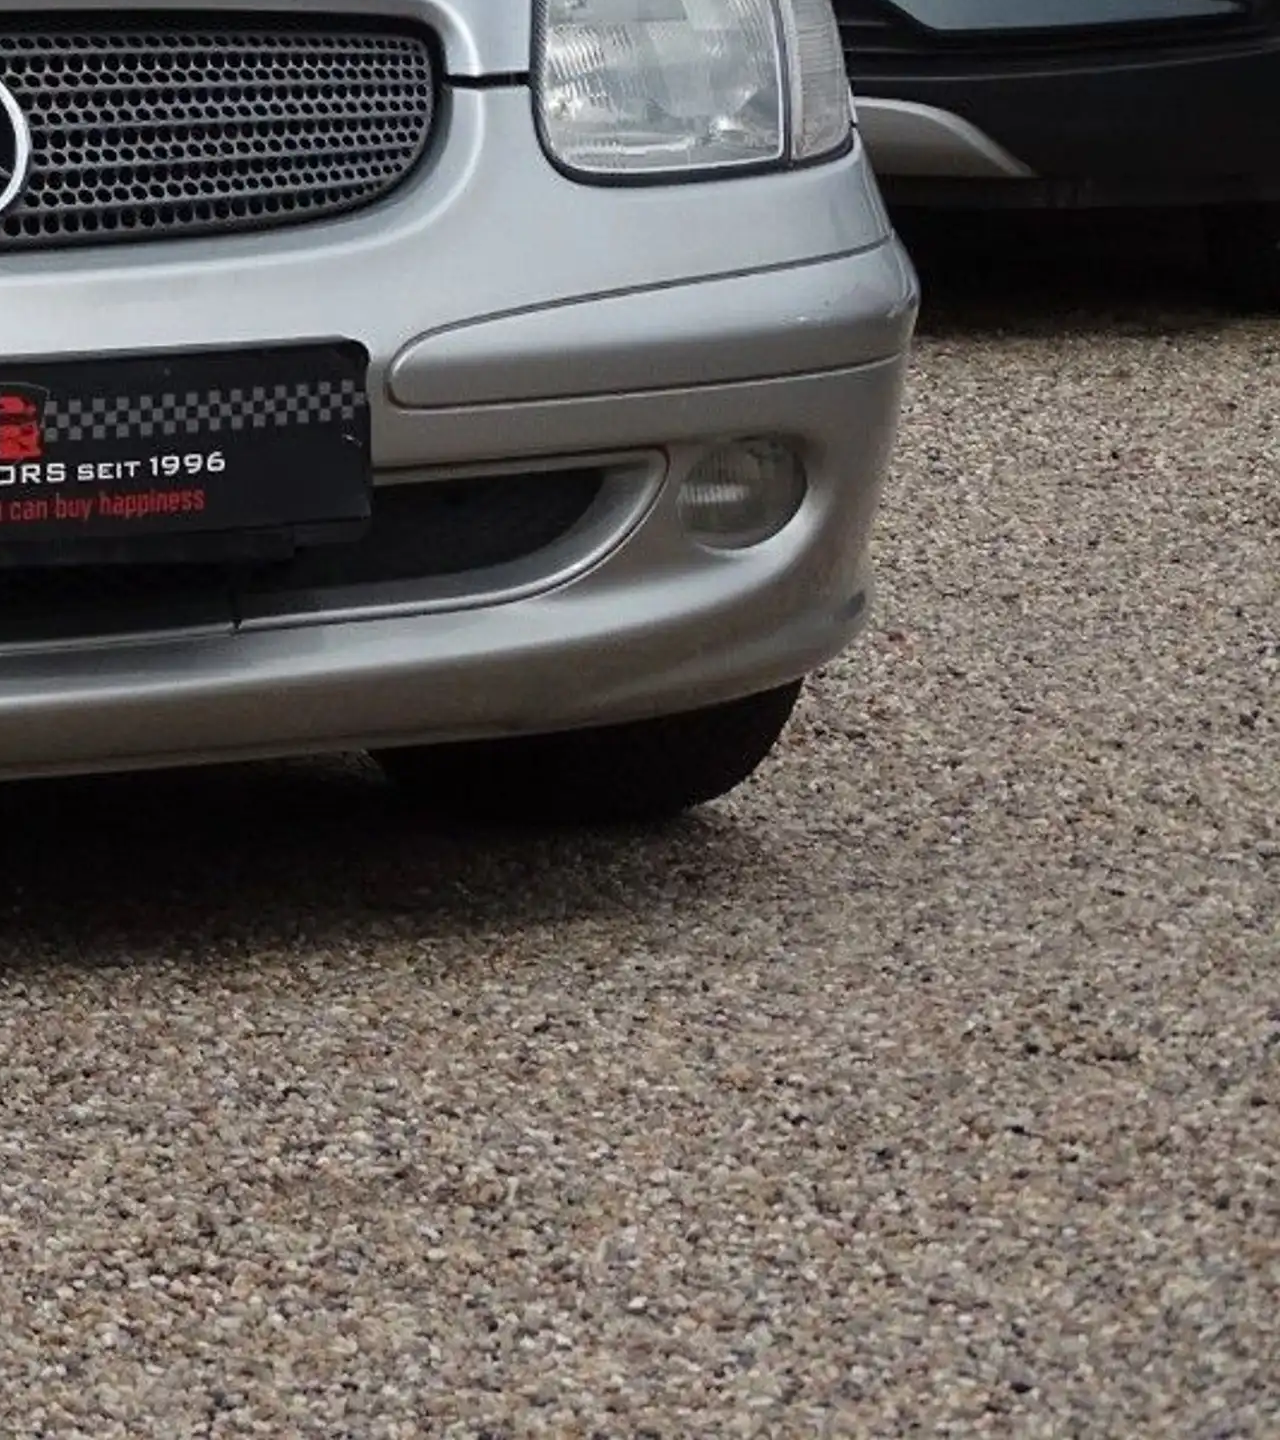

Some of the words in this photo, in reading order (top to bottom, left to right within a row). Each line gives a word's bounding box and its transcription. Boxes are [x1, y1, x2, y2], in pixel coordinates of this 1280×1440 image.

[77, 461, 141, 481] SEIT
[149, 451, 226, 477] 1996
[9, 500, 48, 521] can
[55, 493, 93, 522] buy
[98, 488, 206, 518] happiness
